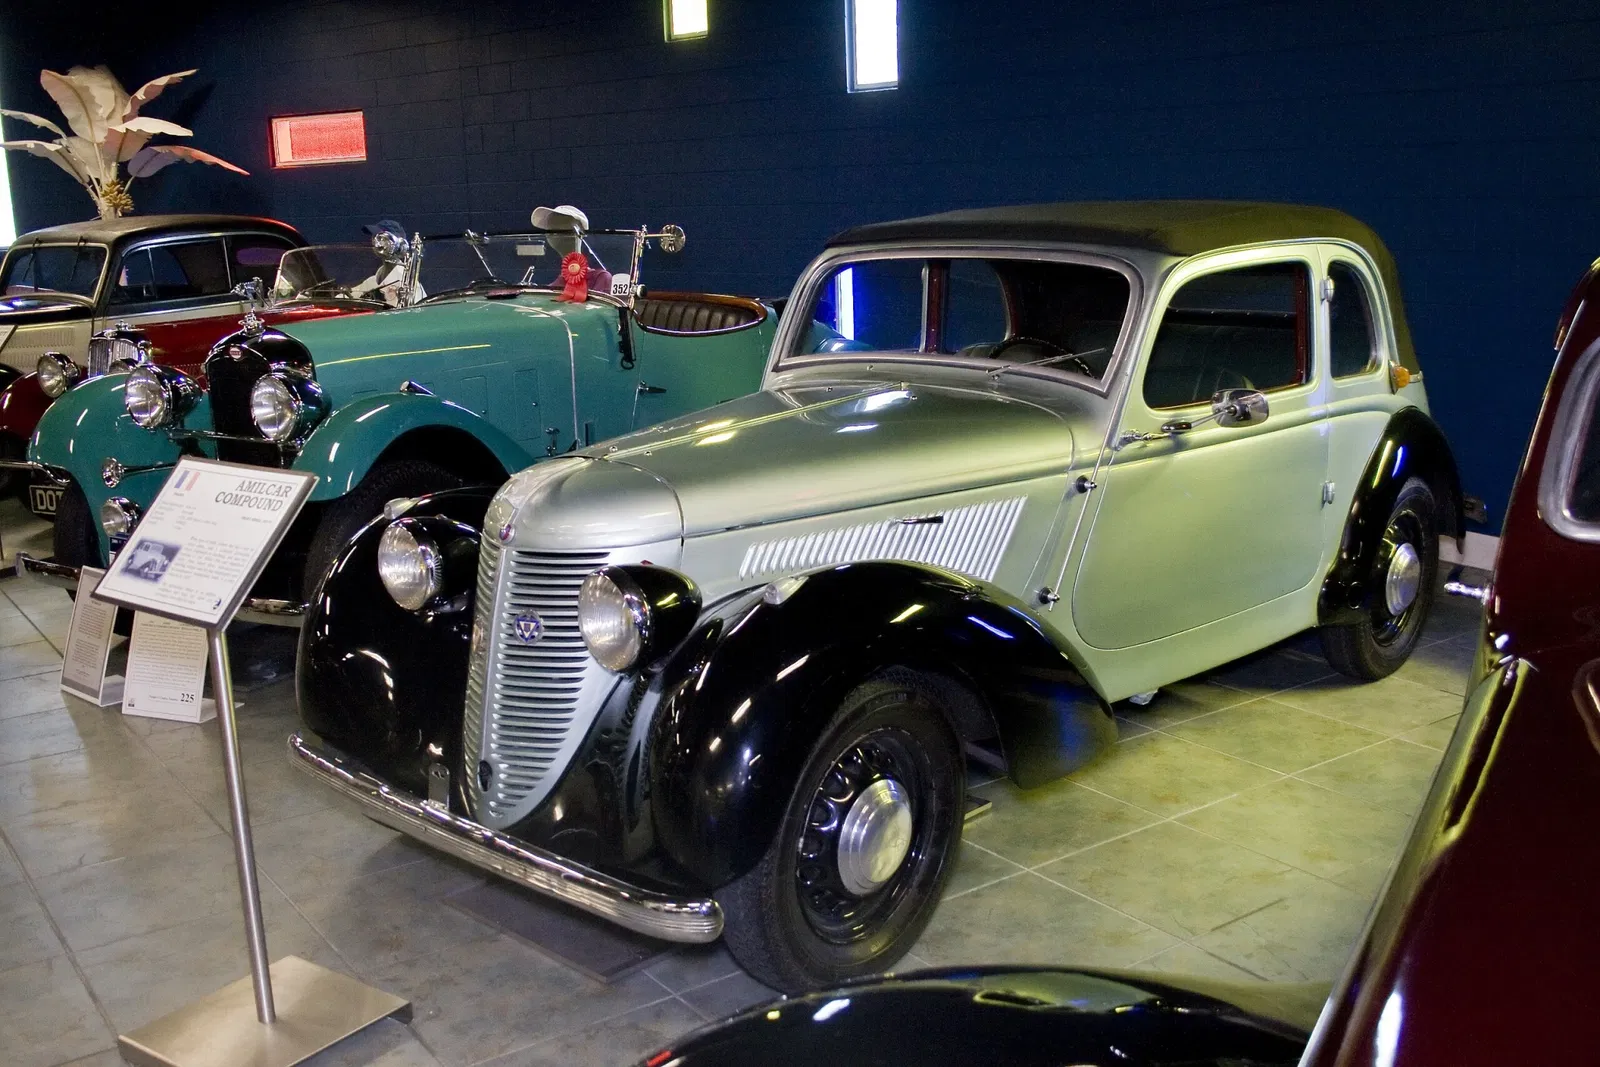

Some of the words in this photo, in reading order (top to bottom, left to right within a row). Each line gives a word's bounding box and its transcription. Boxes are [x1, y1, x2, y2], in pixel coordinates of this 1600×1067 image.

[613, 284, 628, 294] 352
[236, 480, 293, 498] AMILCAR
[215, 491, 284, 512] COMPOUND
[180, 693, 195, 703] 225
